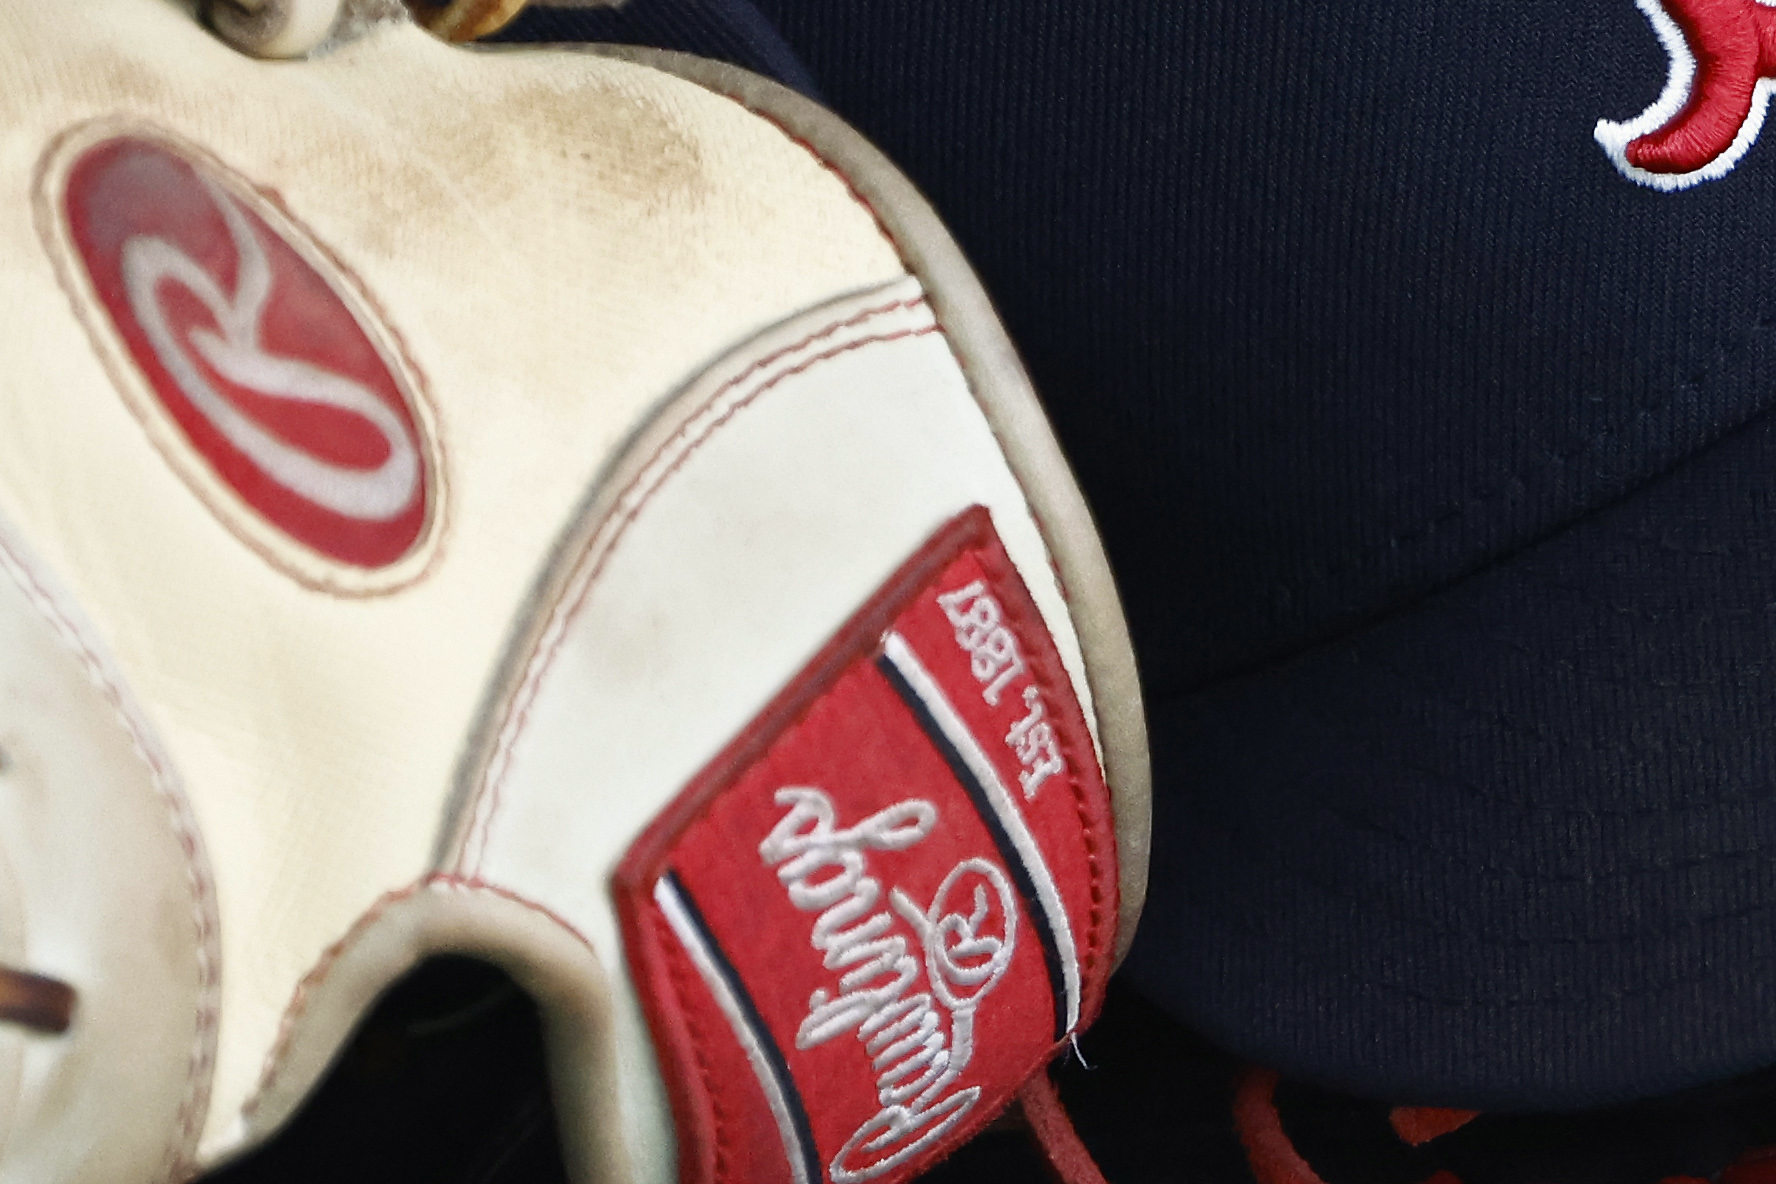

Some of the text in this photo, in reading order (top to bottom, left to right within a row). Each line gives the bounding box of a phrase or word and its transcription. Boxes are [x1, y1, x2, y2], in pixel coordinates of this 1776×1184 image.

[121, 160, 420, 521] R
[937, 579, 1064, 800] Est. 1887
[758, 786, 985, 1183] Rawlings
